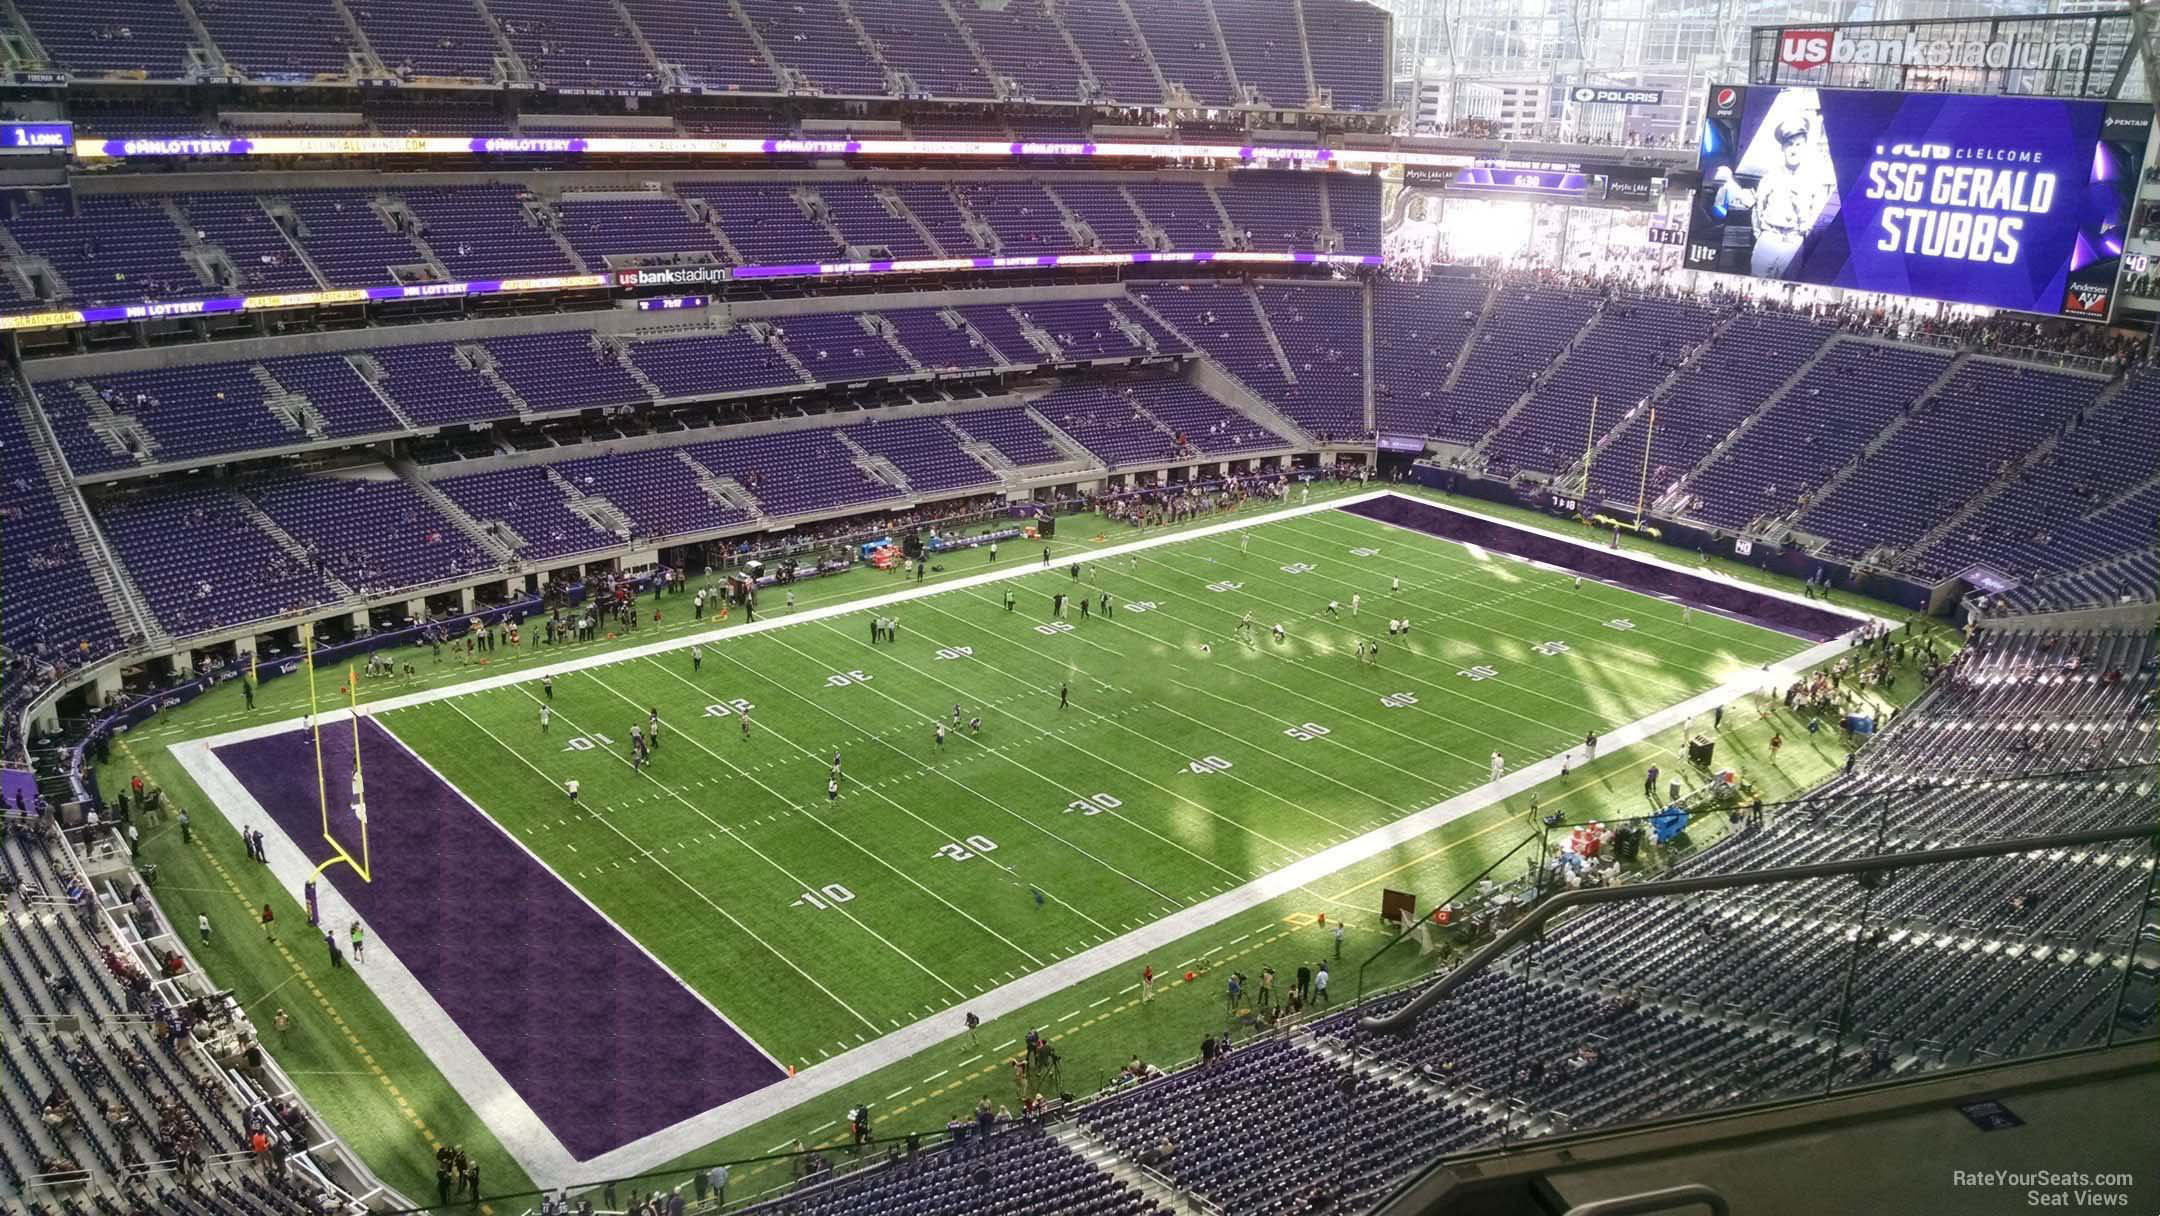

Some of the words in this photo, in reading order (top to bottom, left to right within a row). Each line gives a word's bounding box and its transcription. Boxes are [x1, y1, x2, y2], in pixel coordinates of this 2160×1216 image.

[1597, 91, 1659, 103] POLARIS
[2114, 119, 2149, 127] PENTAIR
[15, 128, 29, 146] 1
[30, 134, 63, 146] LONG
[1865, 161, 1927, 202] SSG
[1929, 165, 2057, 214] GERALD
[1877, 206, 2024, 265] STUBBS
[1689, 244, 1717, 263] Lite
[2125, 255, 2148, 272] 40
[422, 283, 468, 295] LOTTERY
[2070, 282, 2108, 294] Andersen
[126, 307, 146, 317] MN
[149, 302, 204, 316] LOTTERY
[1380, 692, 1419, 708] 40
[1283, 722, 1331, 742] 50
[1188, 755, 1233, 774] 40
[1068, 792, 1123, 816] 30
[938, 834, 999, 862] 20
[800, 883, 856, 911] 10
